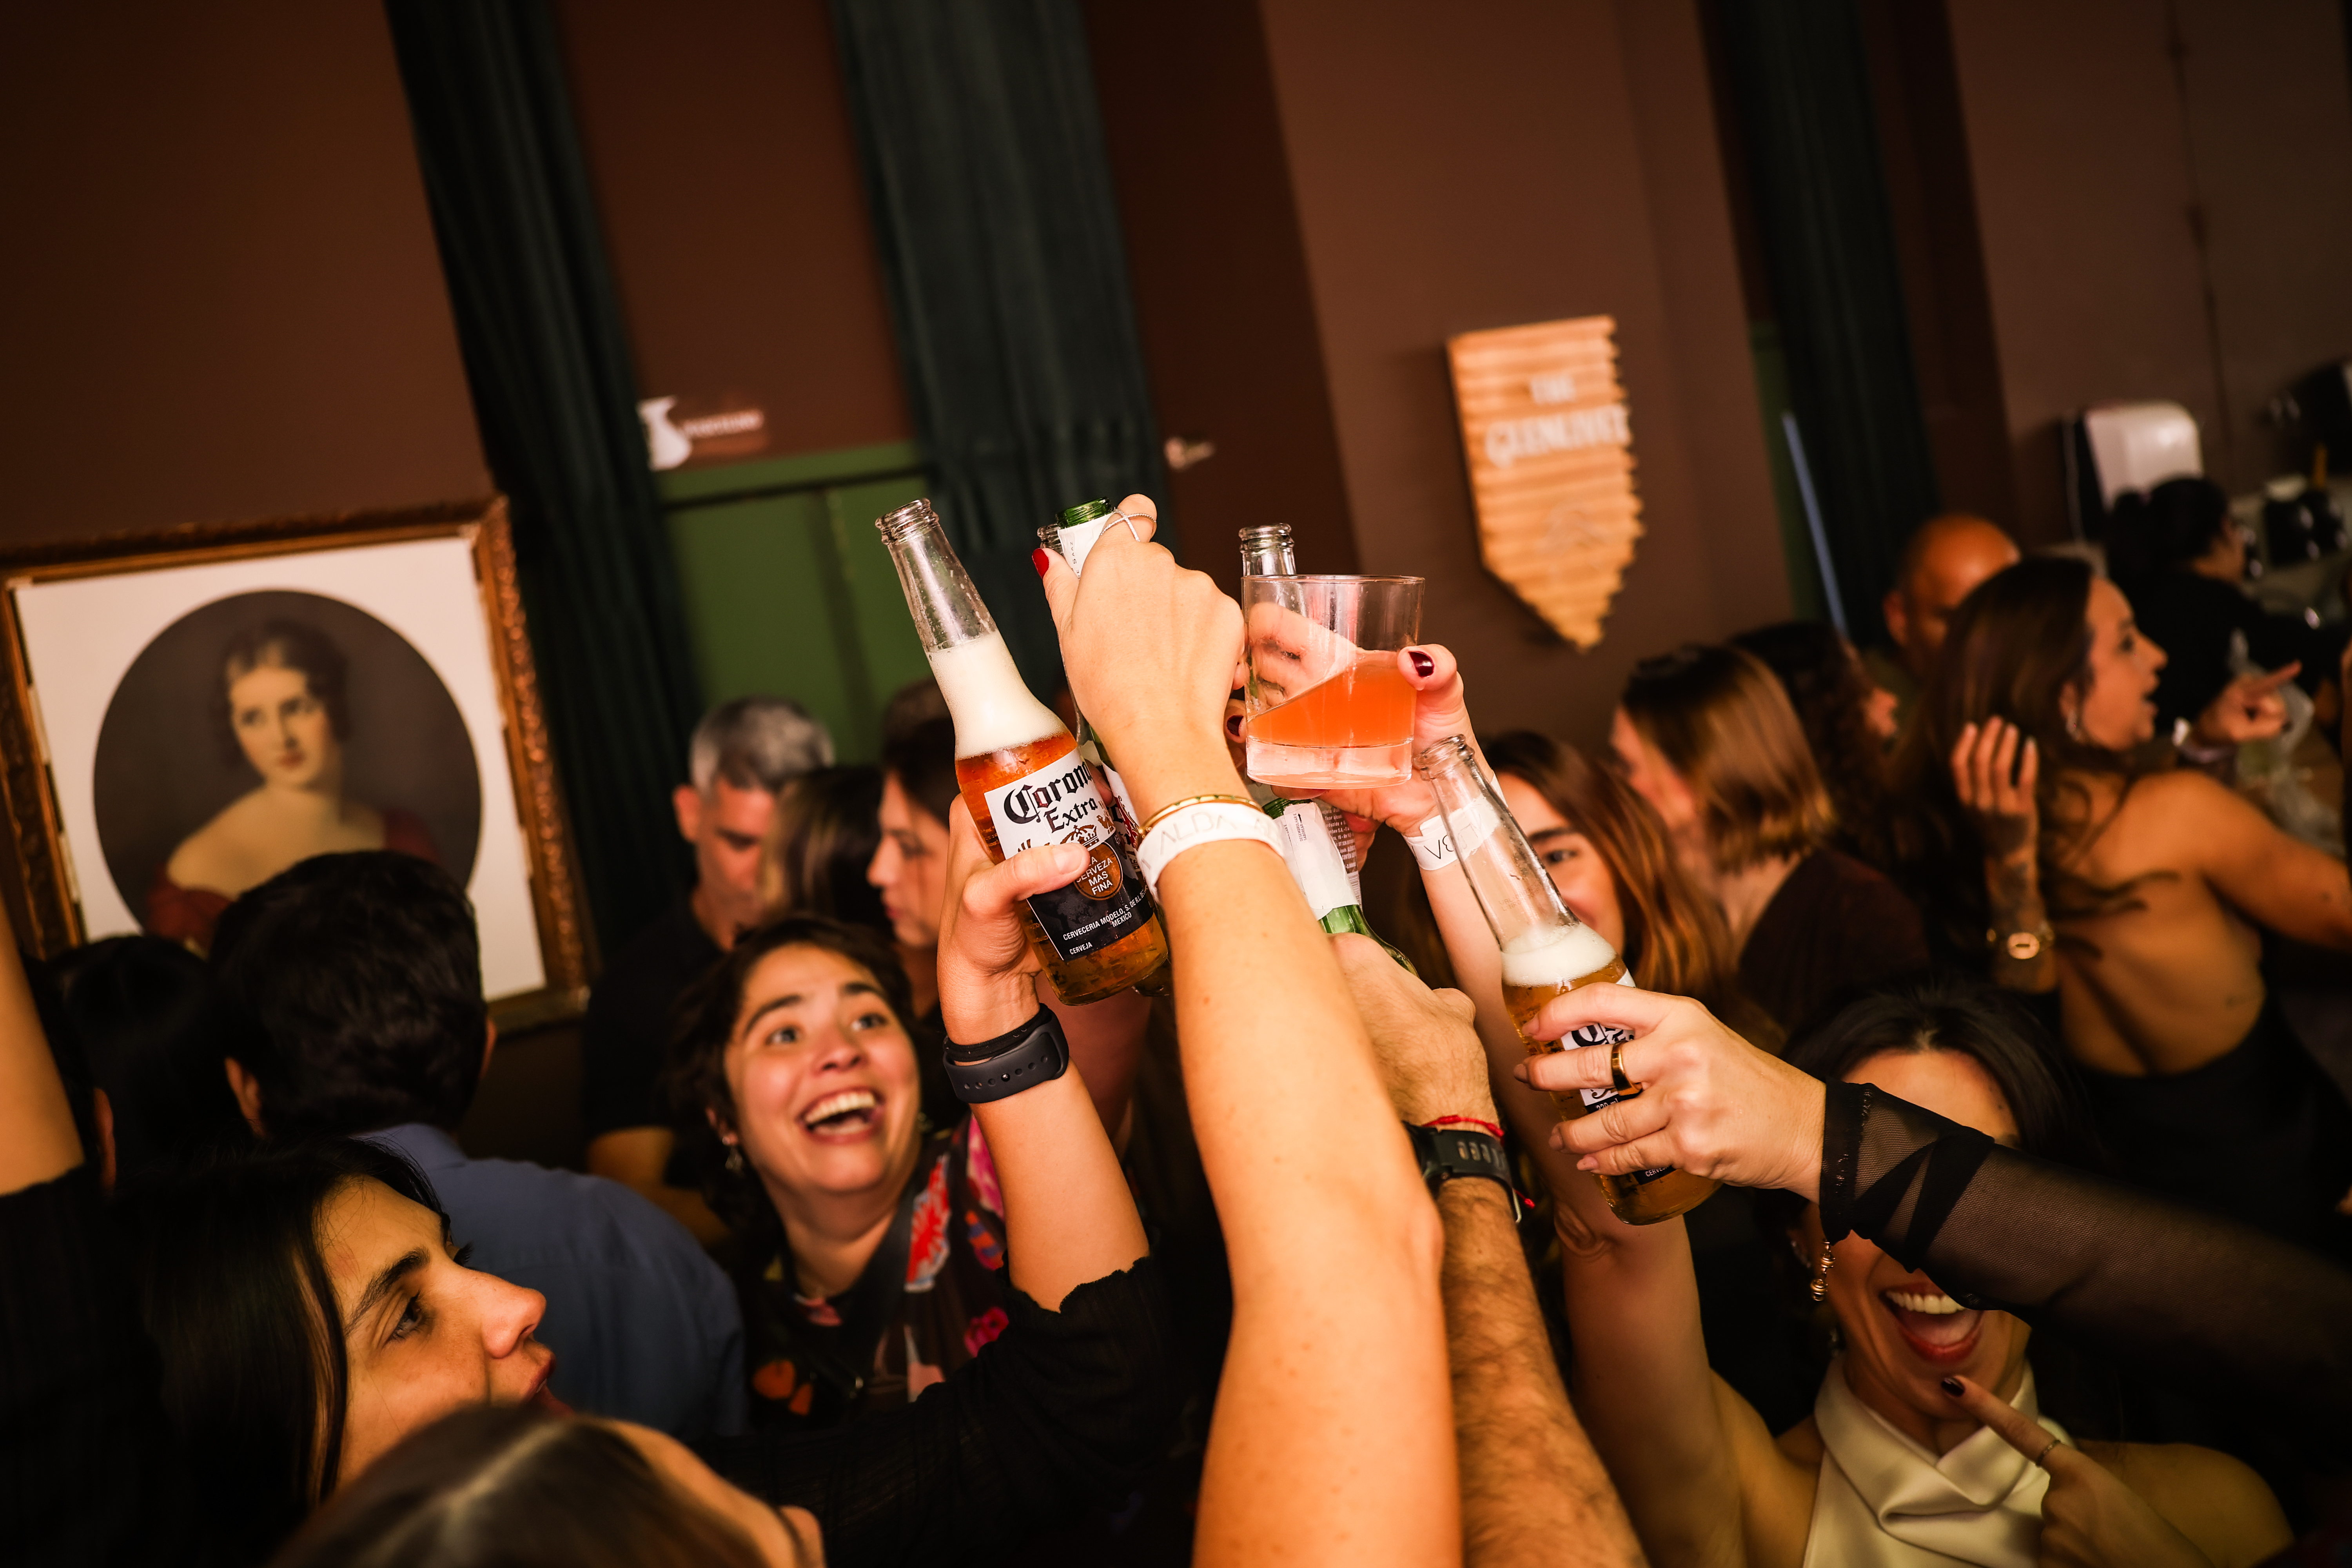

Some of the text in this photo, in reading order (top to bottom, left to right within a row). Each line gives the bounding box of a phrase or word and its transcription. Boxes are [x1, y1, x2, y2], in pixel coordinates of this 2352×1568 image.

[1044, 797, 1098, 833] Extra
[1294, 816, 1303, 842] DESEMBRULHAR
[1089, 857, 1098, 867] A
[1088, 871, 1109, 887] MAS
[1091, 879, 1113, 895] FINA
[1063, 921, 1101, 941] CERVECERIA
[1100, 907, 1126, 925] MODELO,
[1129, 899, 1136, 908] DE
[1111, 911, 1132, 927] MEXICO
[1069, 942, 1093, 955] CERVEJA
[1645, 1167, 1667, 1177] CERVE
